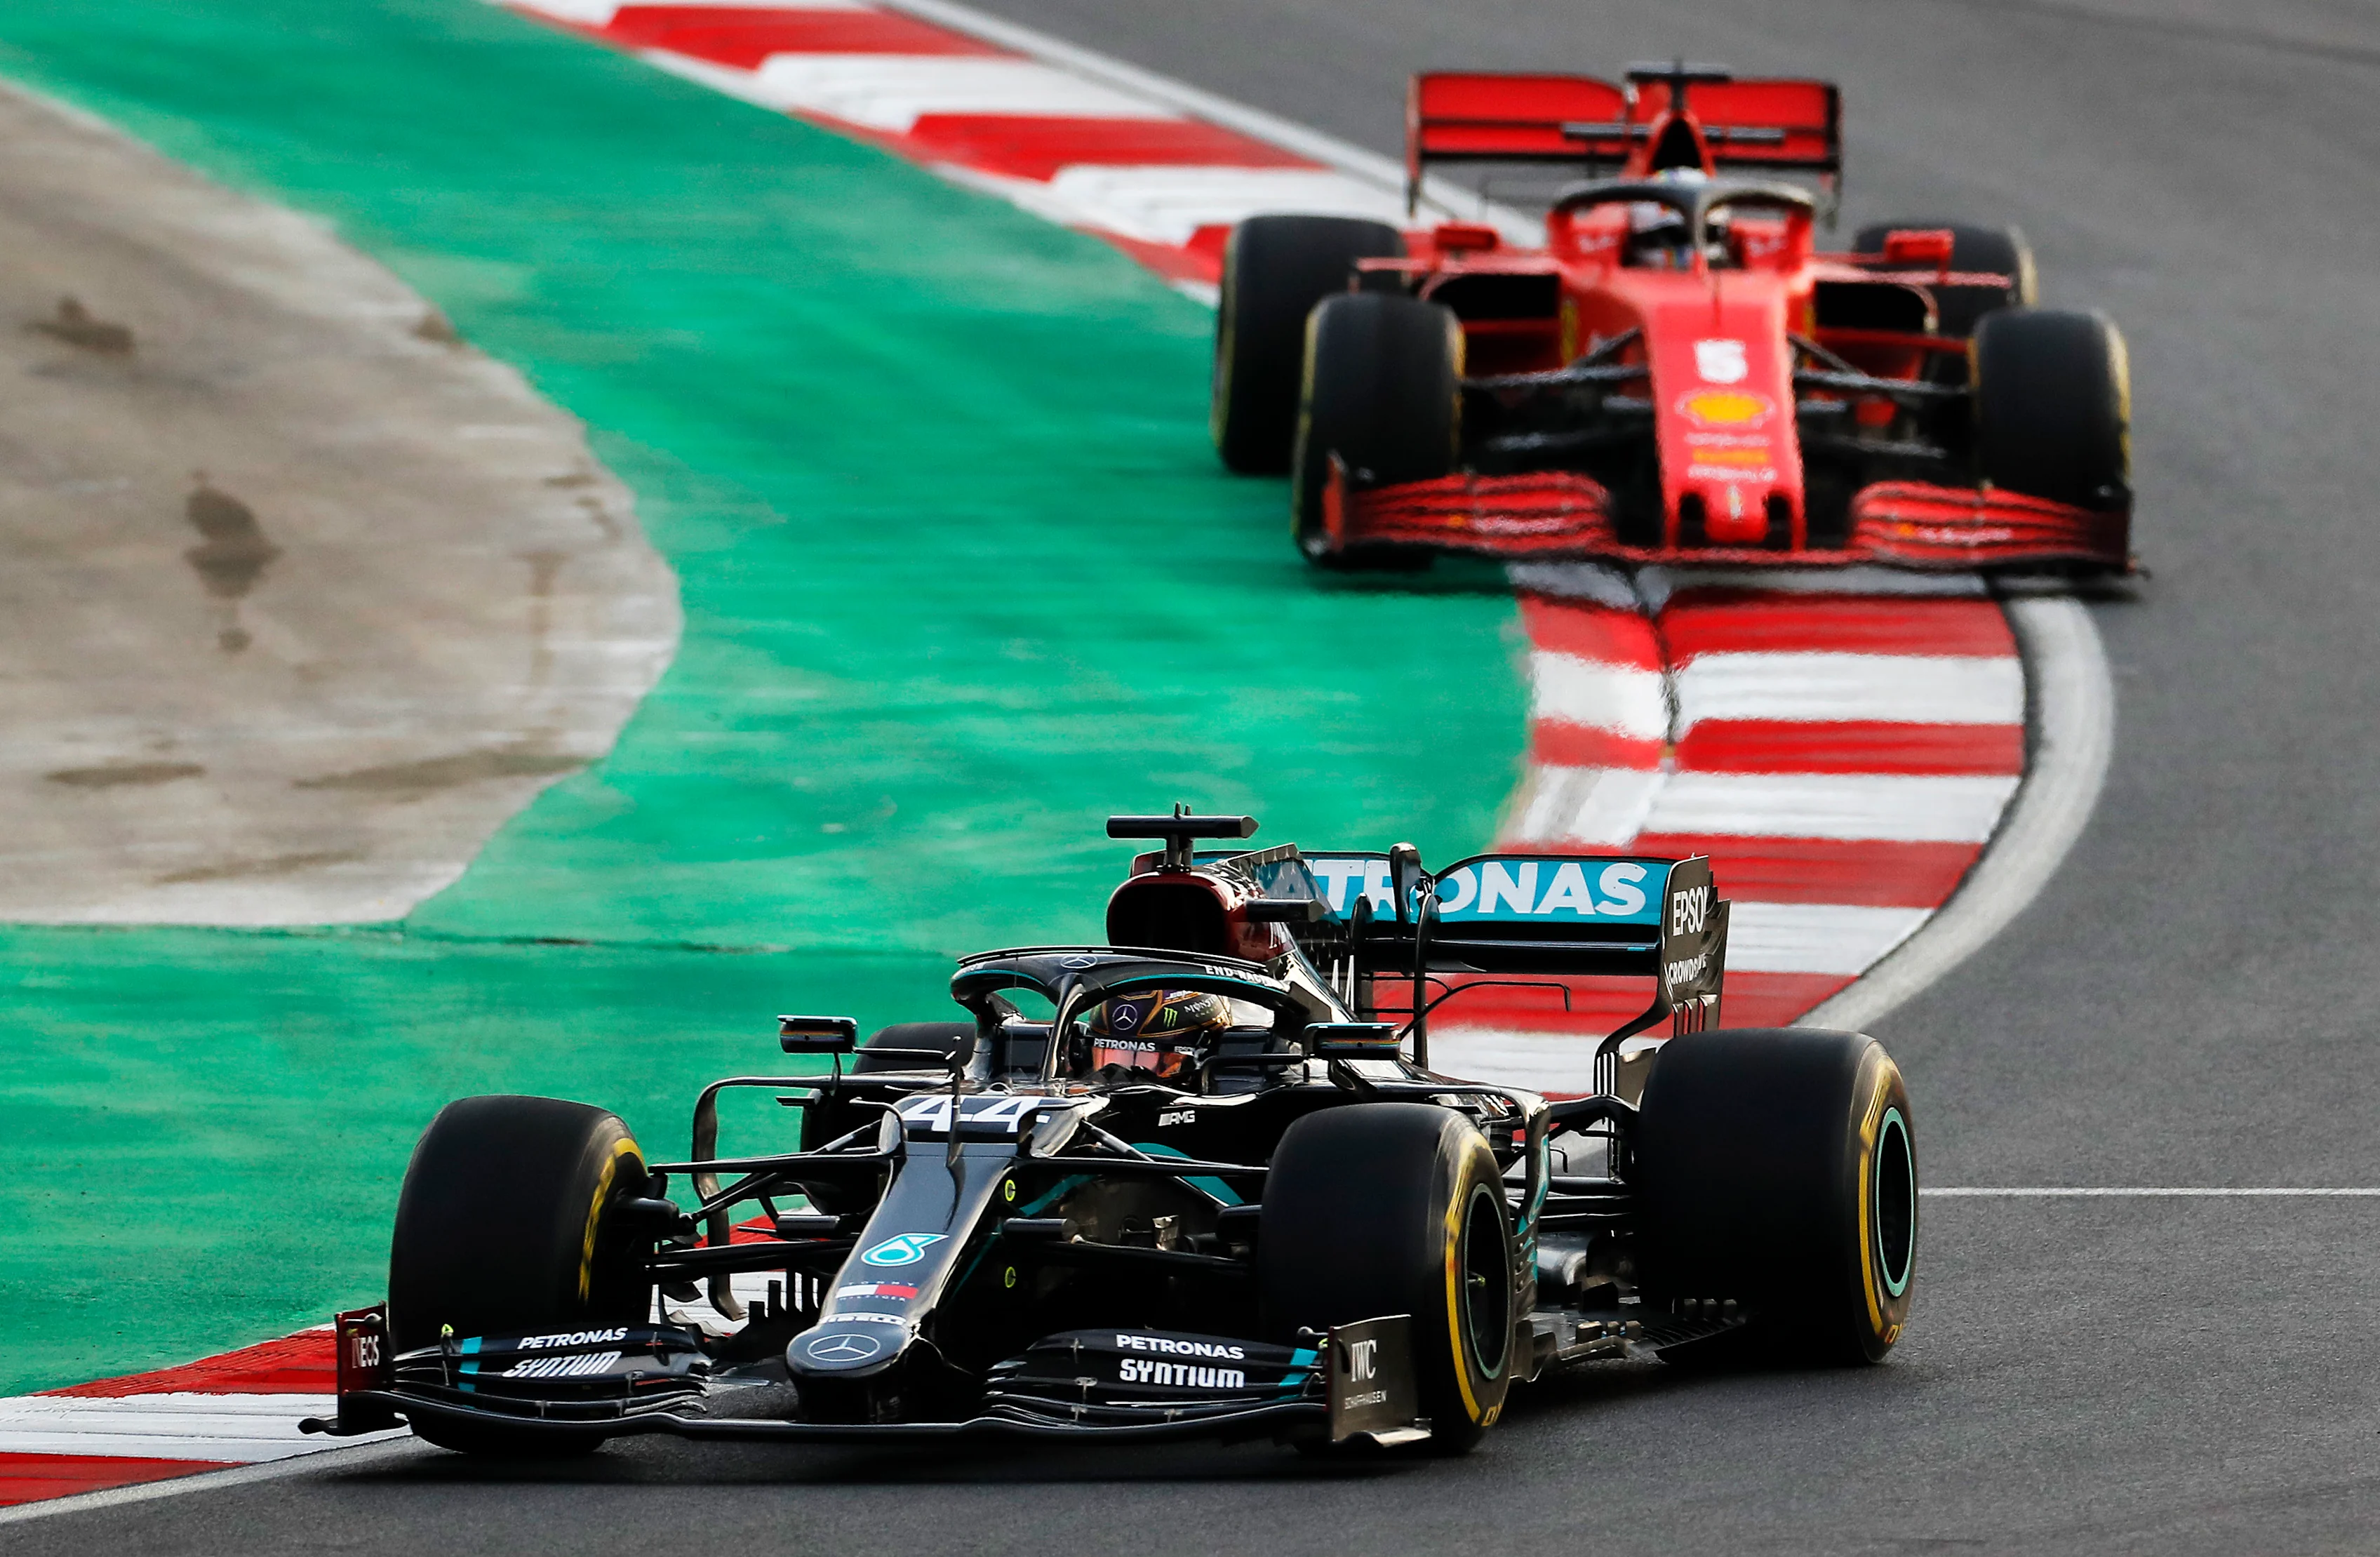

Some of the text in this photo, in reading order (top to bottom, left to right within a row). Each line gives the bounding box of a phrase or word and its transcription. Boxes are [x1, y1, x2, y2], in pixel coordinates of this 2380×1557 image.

[1695, 339, 1749, 384] 5
[1304, 859, 1647, 916] TRONAS
[1094, 1038, 1156, 1052] PETRONAS
[901, 1095, 1050, 1132] 44
[1170, 1110, 1196, 1124] AMG
[352, 1335, 380, 1368] INEOS
[516, 1328, 629, 1350] PETRONAS
[1116, 1334, 1245, 1360] PETRONAS
[502, 1351, 622, 1378] SYNTIUM
[1119, 1358, 1245, 1389] SYNTIUM
[1351, 1339, 1377, 1382] IWC
